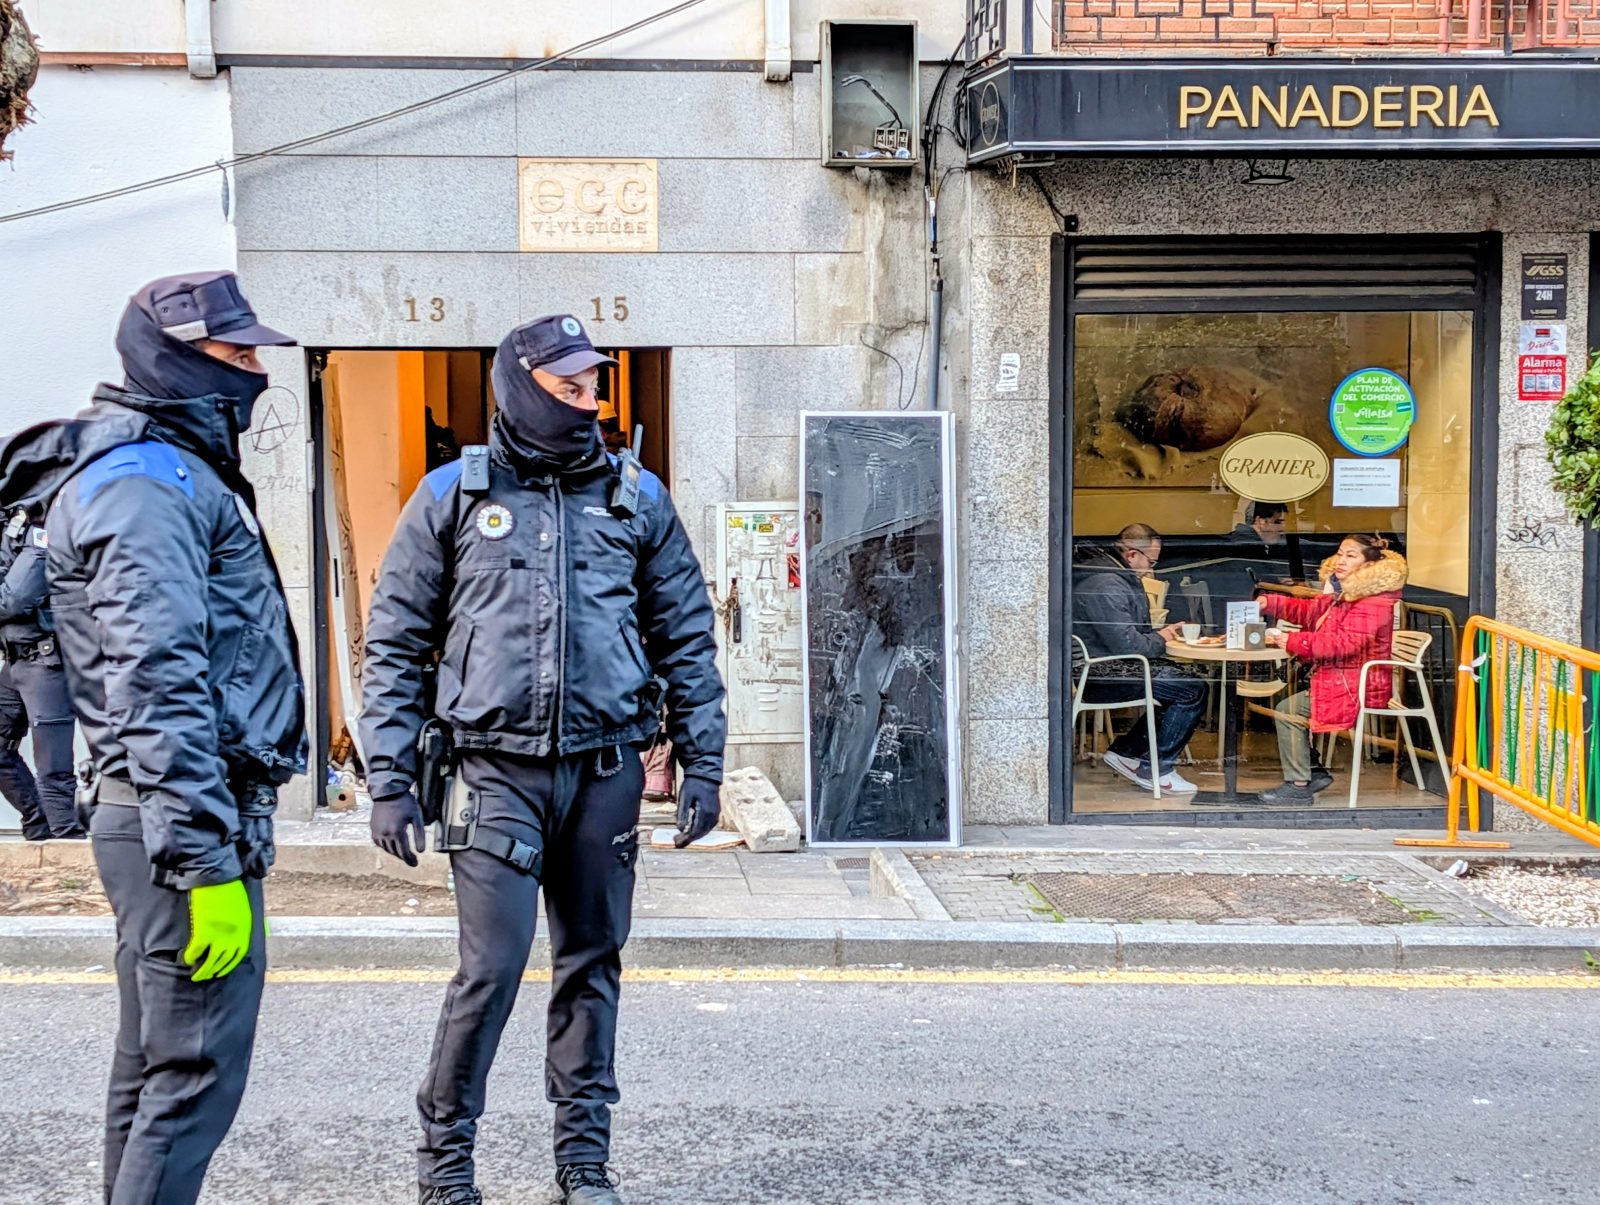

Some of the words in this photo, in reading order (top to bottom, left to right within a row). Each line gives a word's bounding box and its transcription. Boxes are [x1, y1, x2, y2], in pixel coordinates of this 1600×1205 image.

[1179, 84, 1500, 128] PANADERIA
[531, 216, 648, 235] viviendas
[1535, 290, 1553, 301] 24H
[403, 296, 445, 322] 13
[590, 296, 630, 322] 15
[1522, 356, 1563, 368] Alarma
[1356, 376, 1379, 384] PLAN
[1381, 376, 1393, 384] DE
[1342, 393, 1358, 401] DEL
[1360, 393, 1406, 401] COMERCIO
[1225, 458, 1316, 479] GRANIER
